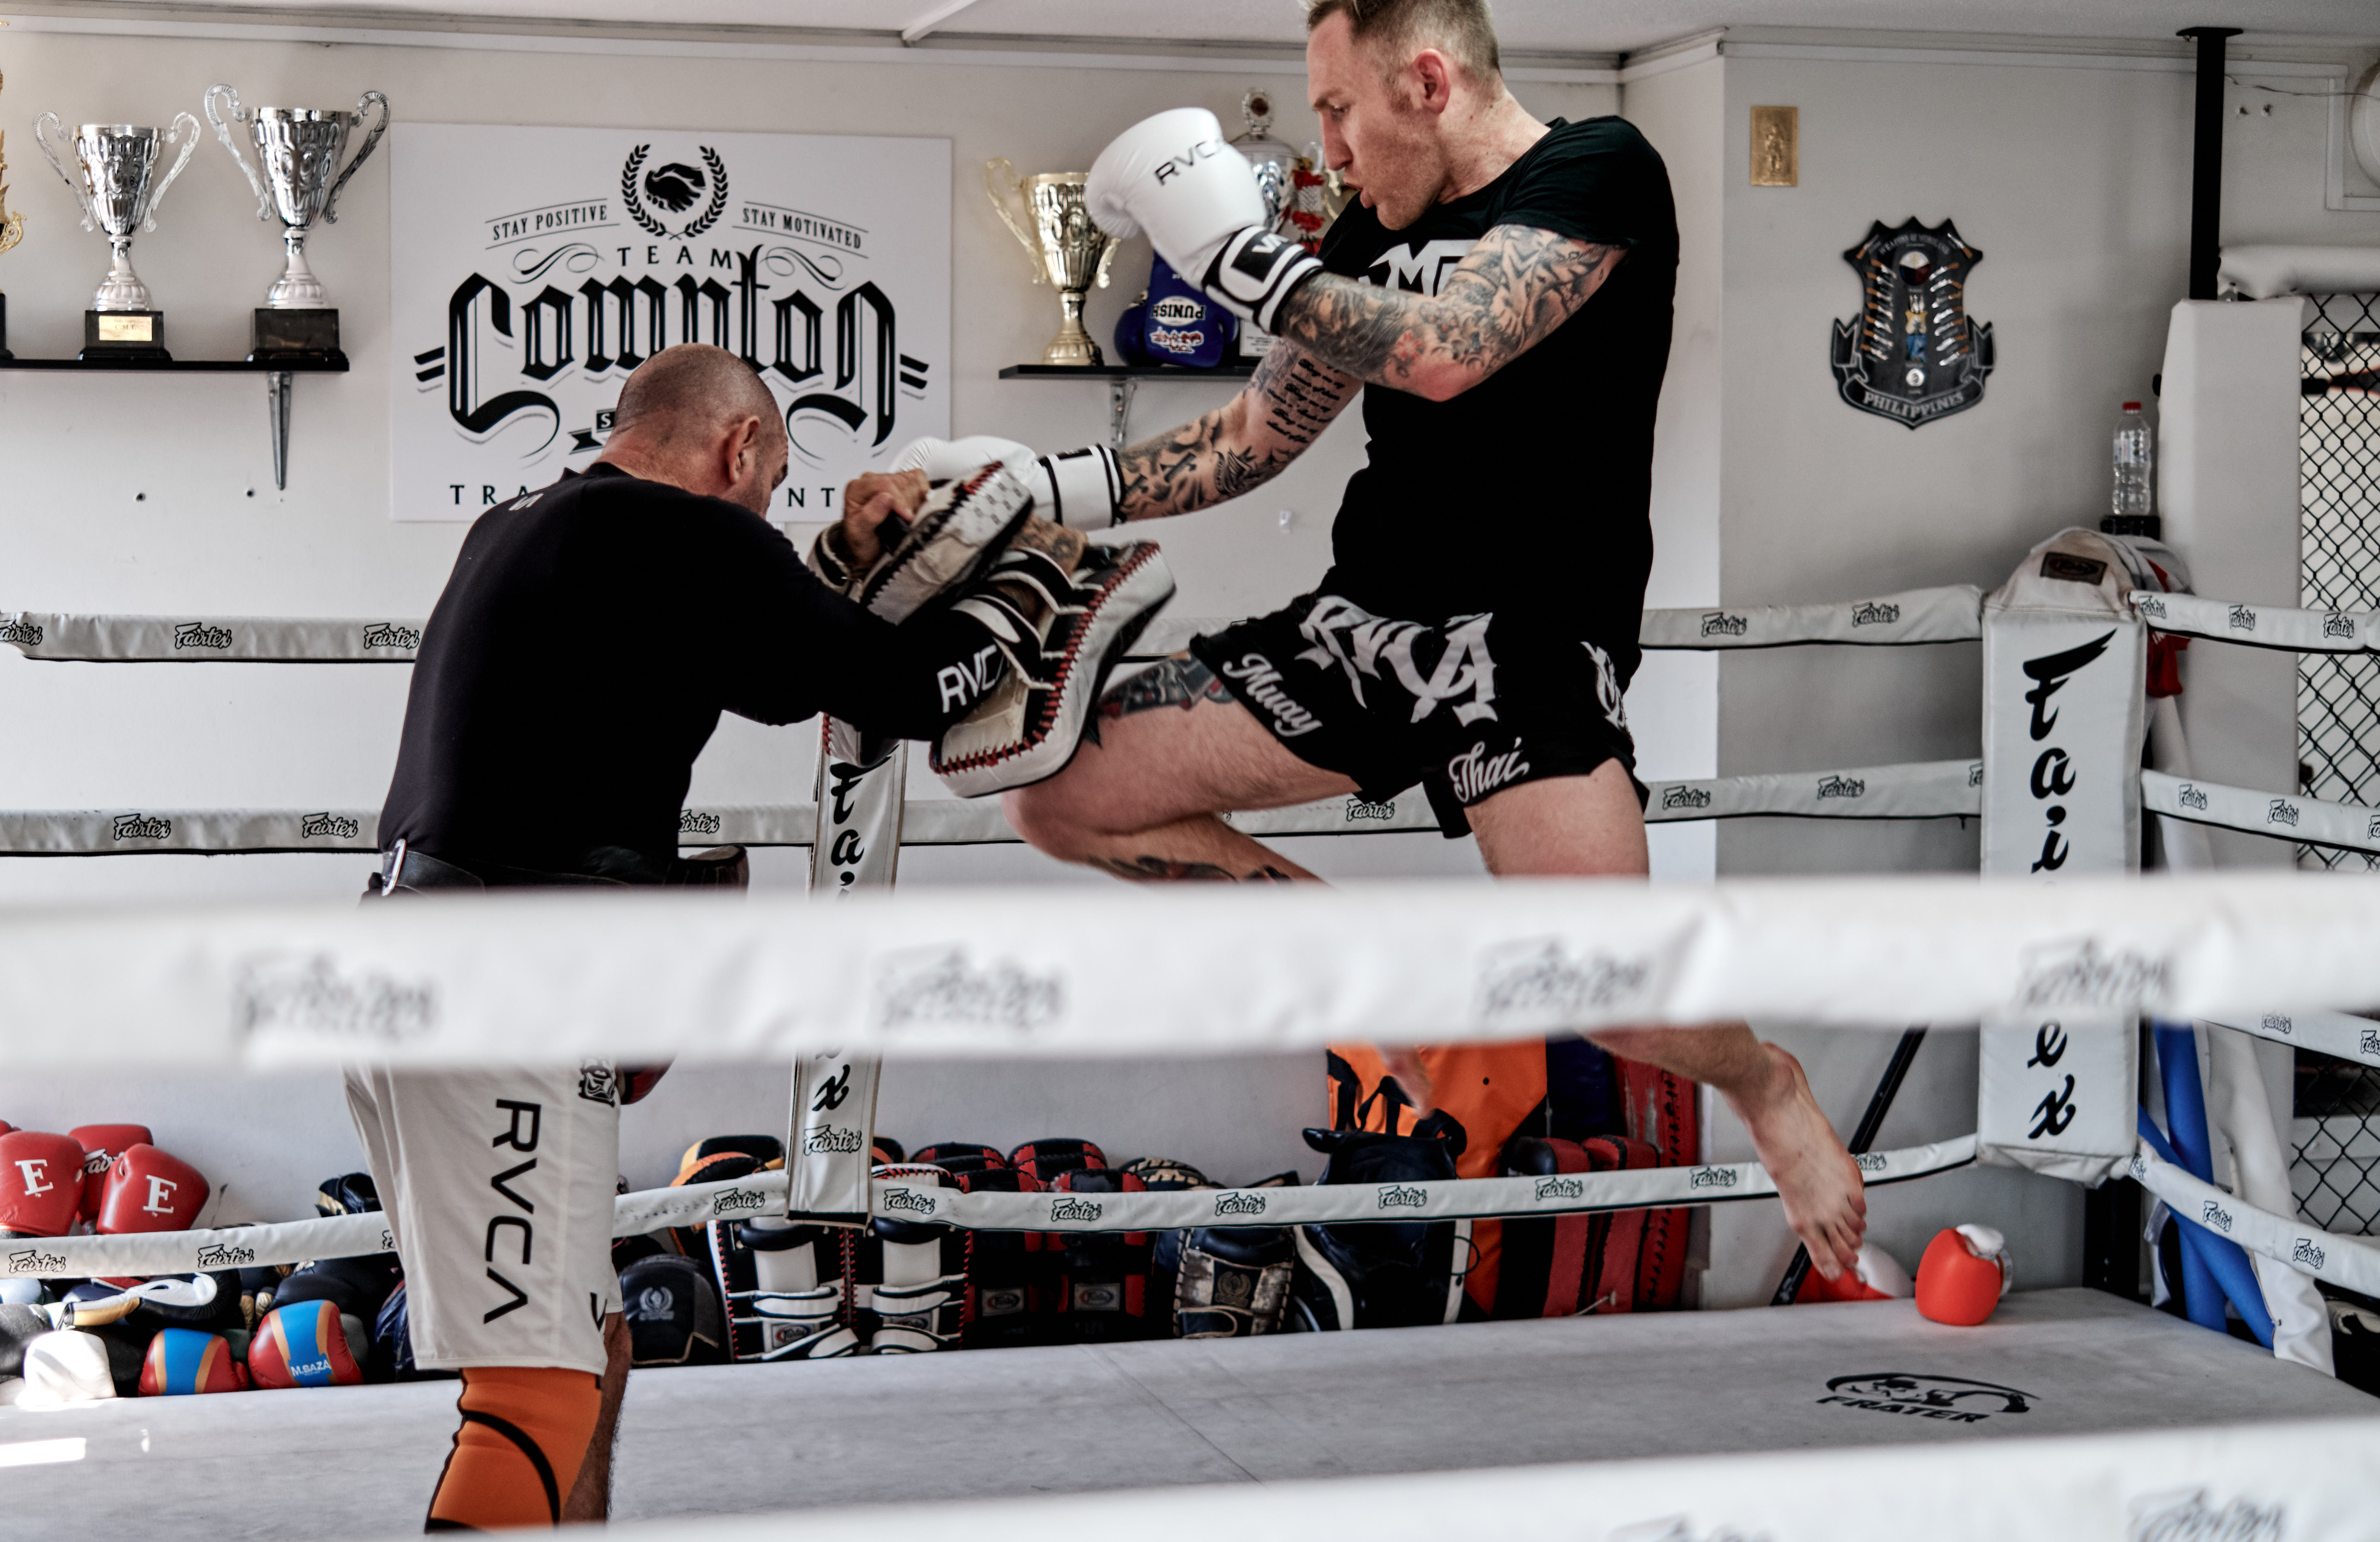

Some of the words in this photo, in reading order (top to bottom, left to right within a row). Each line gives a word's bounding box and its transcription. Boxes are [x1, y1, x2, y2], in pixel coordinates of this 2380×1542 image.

[1155, 141, 1220, 186] RVC
[493, 217, 528, 240] STAY
[536, 205, 607, 230] POSITIVE
[743, 208, 775, 227] STAY
[783, 214, 861, 248] MOTIVATED
[617, 245, 732, 269] TEAM
[1150, 304, 1206, 321] PUNISH
[448, 244, 896, 448] Compton
[937, 644, 1005, 713] RVC
[1223, 653, 1323, 737] Muay
[1448, 737, 1530, 803] Thai
[2022, 628, 2117, 1140] Faiex
[15, 1159, 54, 1196] E
[143, 1175, 177, 1214] E
[484, 1099, 542, 1325] RVCA
[1816, 1396, 1991, 1423] FRATER
